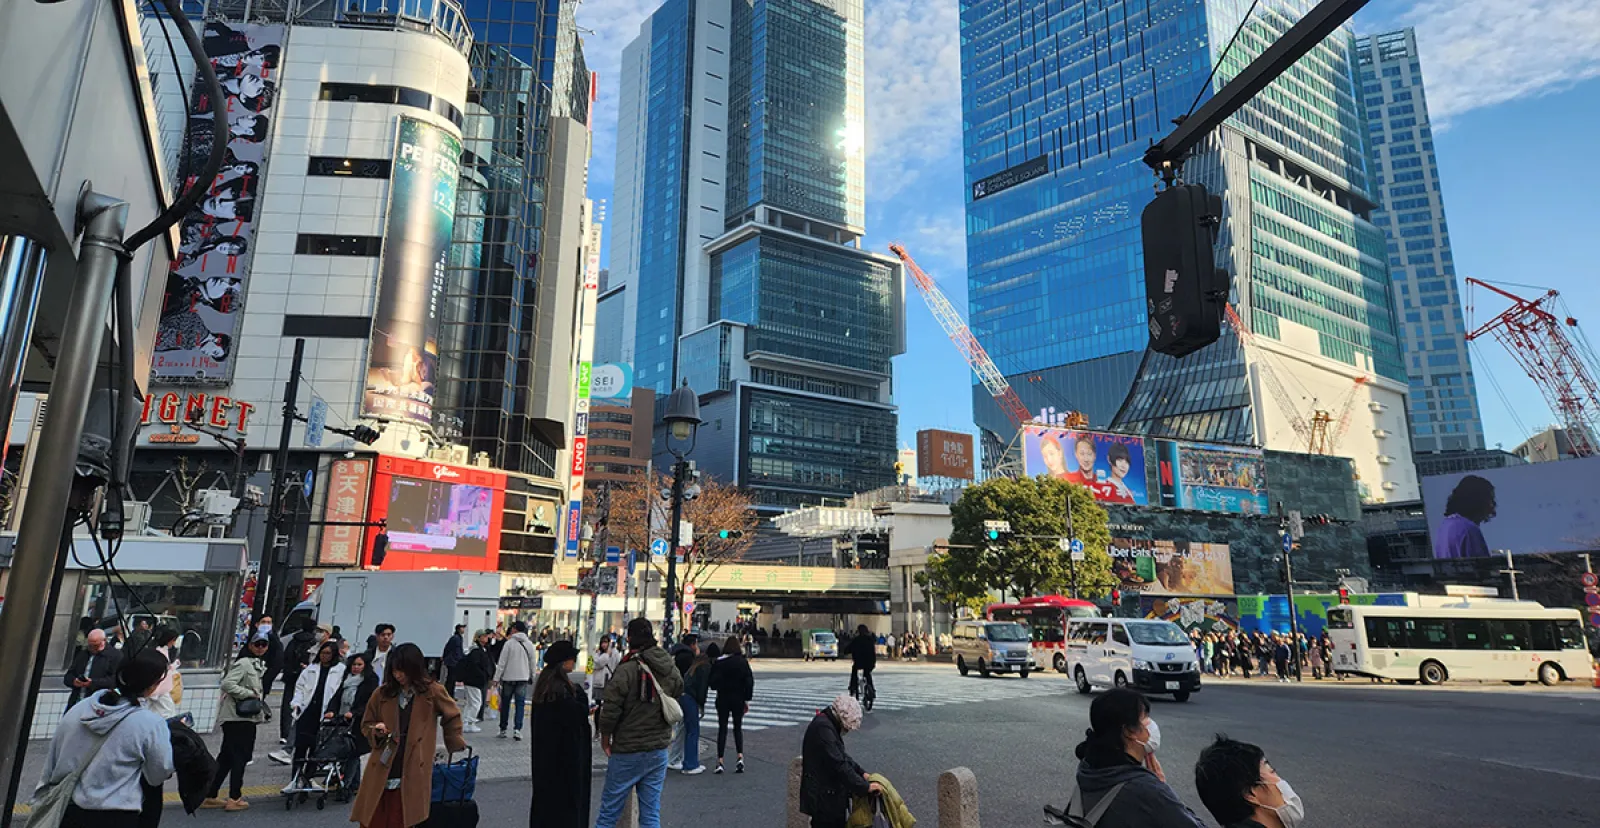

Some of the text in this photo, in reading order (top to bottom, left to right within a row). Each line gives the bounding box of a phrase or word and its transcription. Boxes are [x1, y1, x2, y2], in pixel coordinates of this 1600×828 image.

[163, 293, 234, 314] TER
[1160, 460, 1174, 486] N
[1106, 545, 1130, 558] Uber
[1131, 547, 1150, 558] Eats
